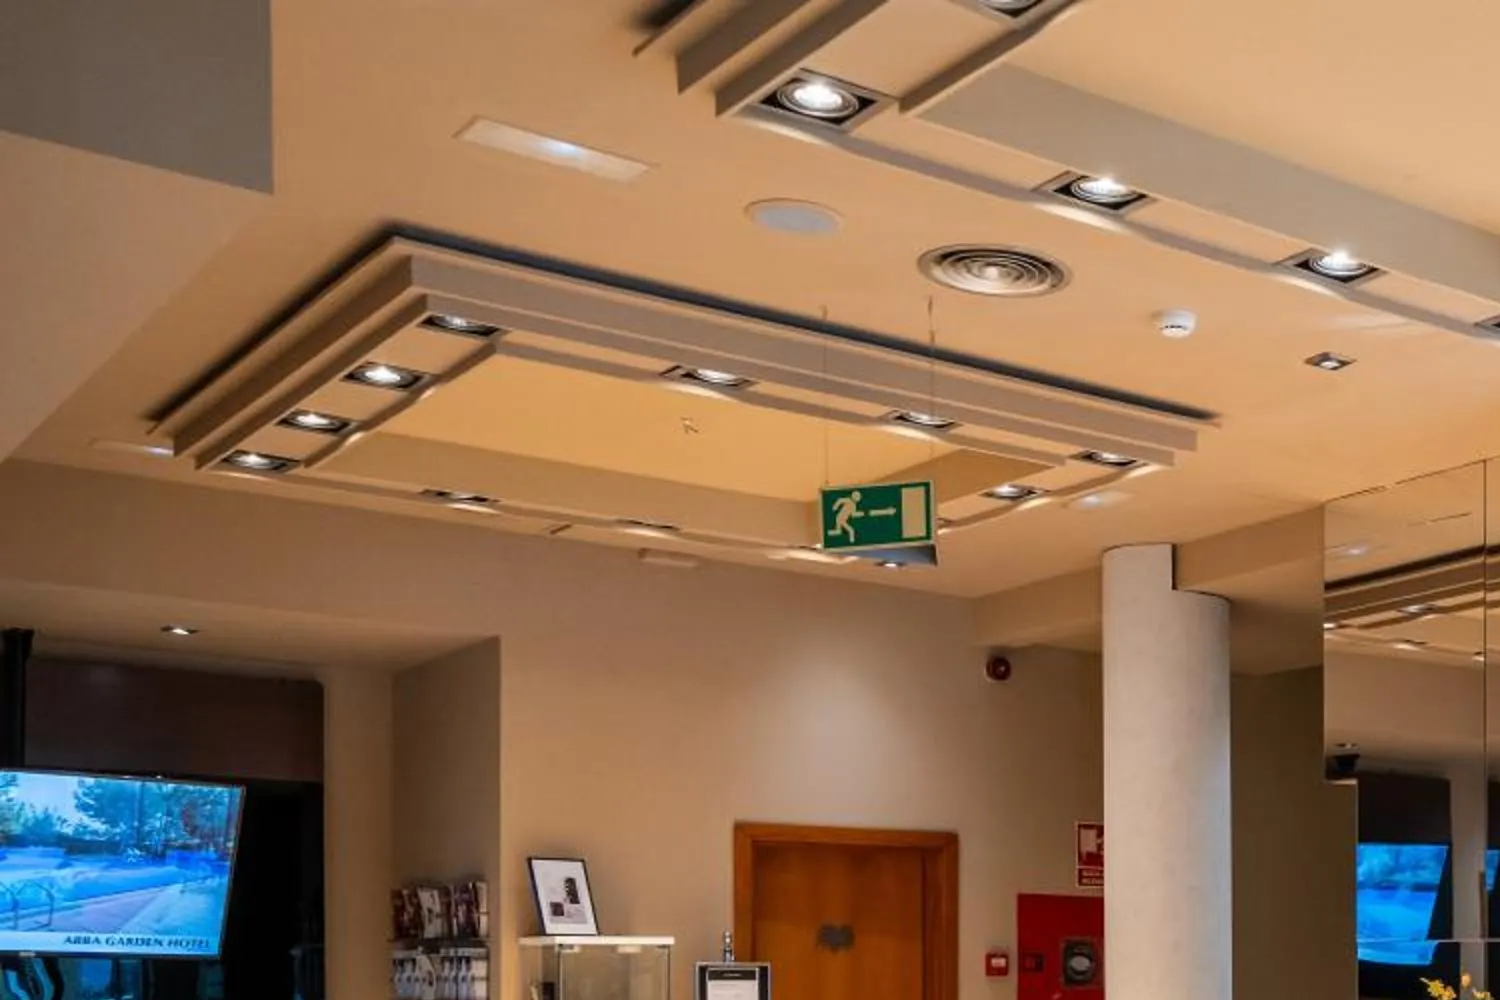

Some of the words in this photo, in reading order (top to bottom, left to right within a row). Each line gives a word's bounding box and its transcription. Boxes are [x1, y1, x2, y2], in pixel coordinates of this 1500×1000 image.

[63, 935, 101, 946] ABBA
[105, 935, 163, 948] GARDEN
[167, 938, 209, 949] HOTEL
